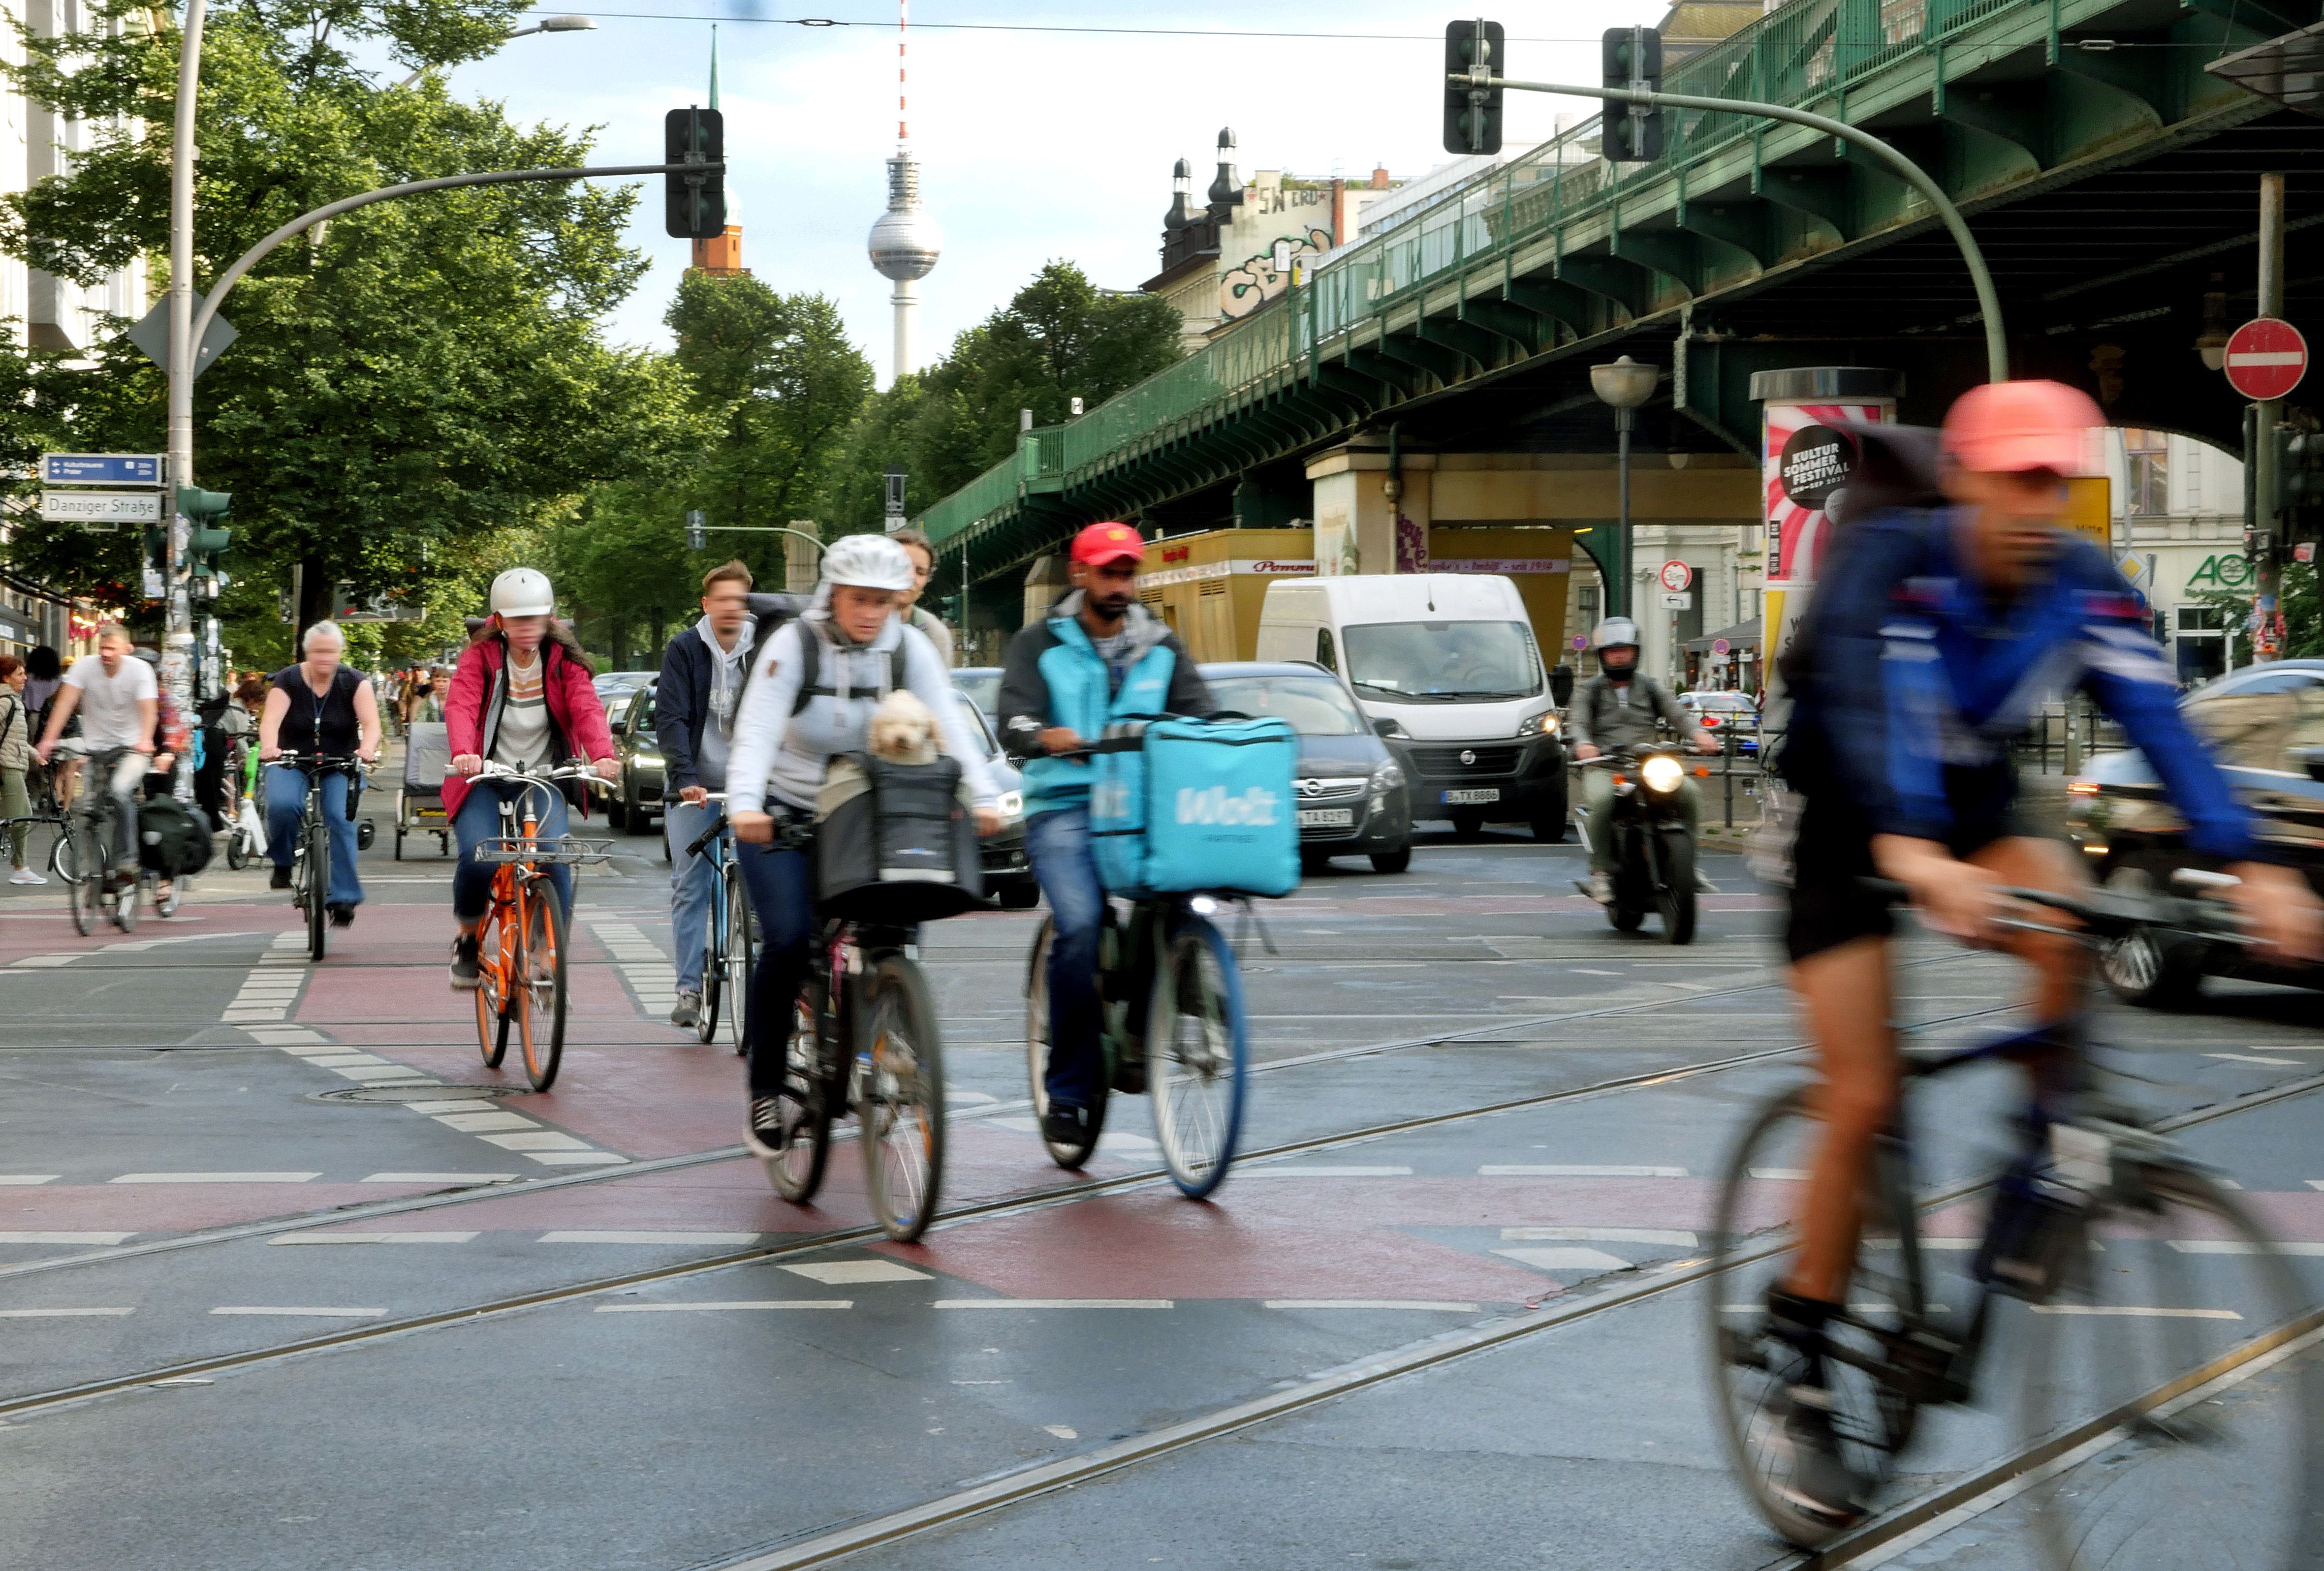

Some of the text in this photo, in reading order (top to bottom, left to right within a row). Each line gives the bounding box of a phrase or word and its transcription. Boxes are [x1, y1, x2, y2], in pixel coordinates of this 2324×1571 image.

[1792, 443, 1839, 464] KULTUR
[1783, 454, 1837, 478] SOMMER
[1793, 461, 1850, 486] FESTIVAL
[50, 498, 154, 516] Danziger Straße
[2076, 524, 2102, 534] Mitte
